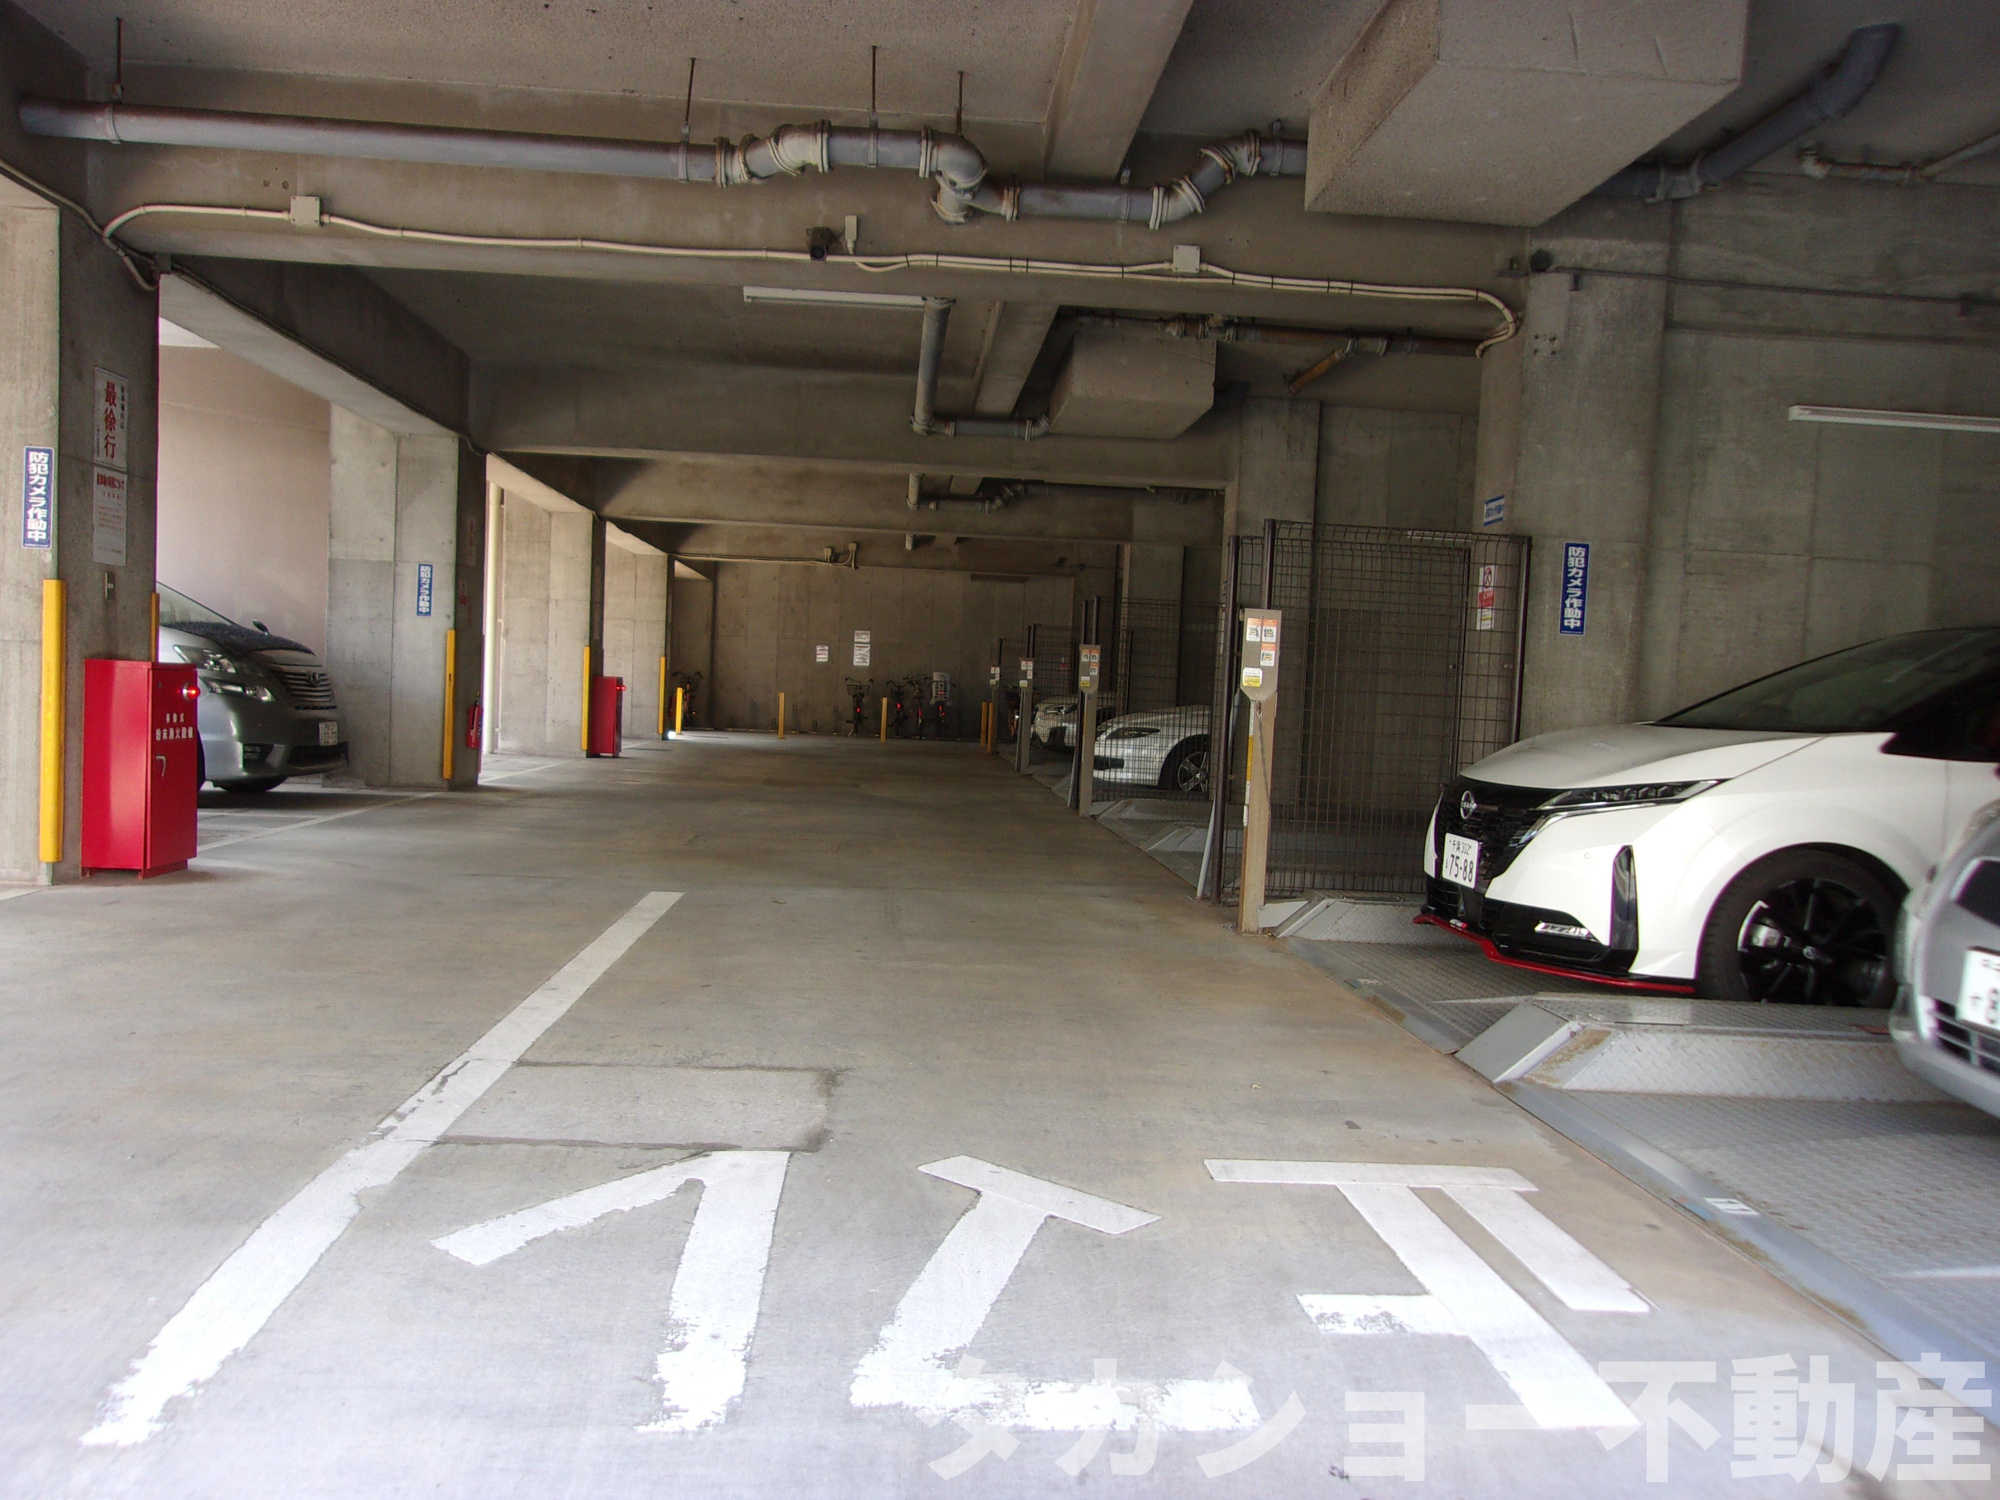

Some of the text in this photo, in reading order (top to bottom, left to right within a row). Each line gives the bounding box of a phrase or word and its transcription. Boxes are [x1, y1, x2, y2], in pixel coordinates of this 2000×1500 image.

[104, 381, 117, 459] 最徐行
[27, 451, 49, 542] 防犯カメラ作動中
[419, 565, 431, 614] 防犯カメラ作動中
[1564, 546, 1586, 629] 防犯カメラ作動中
[1449, 853, 1474, 883] 75-88
